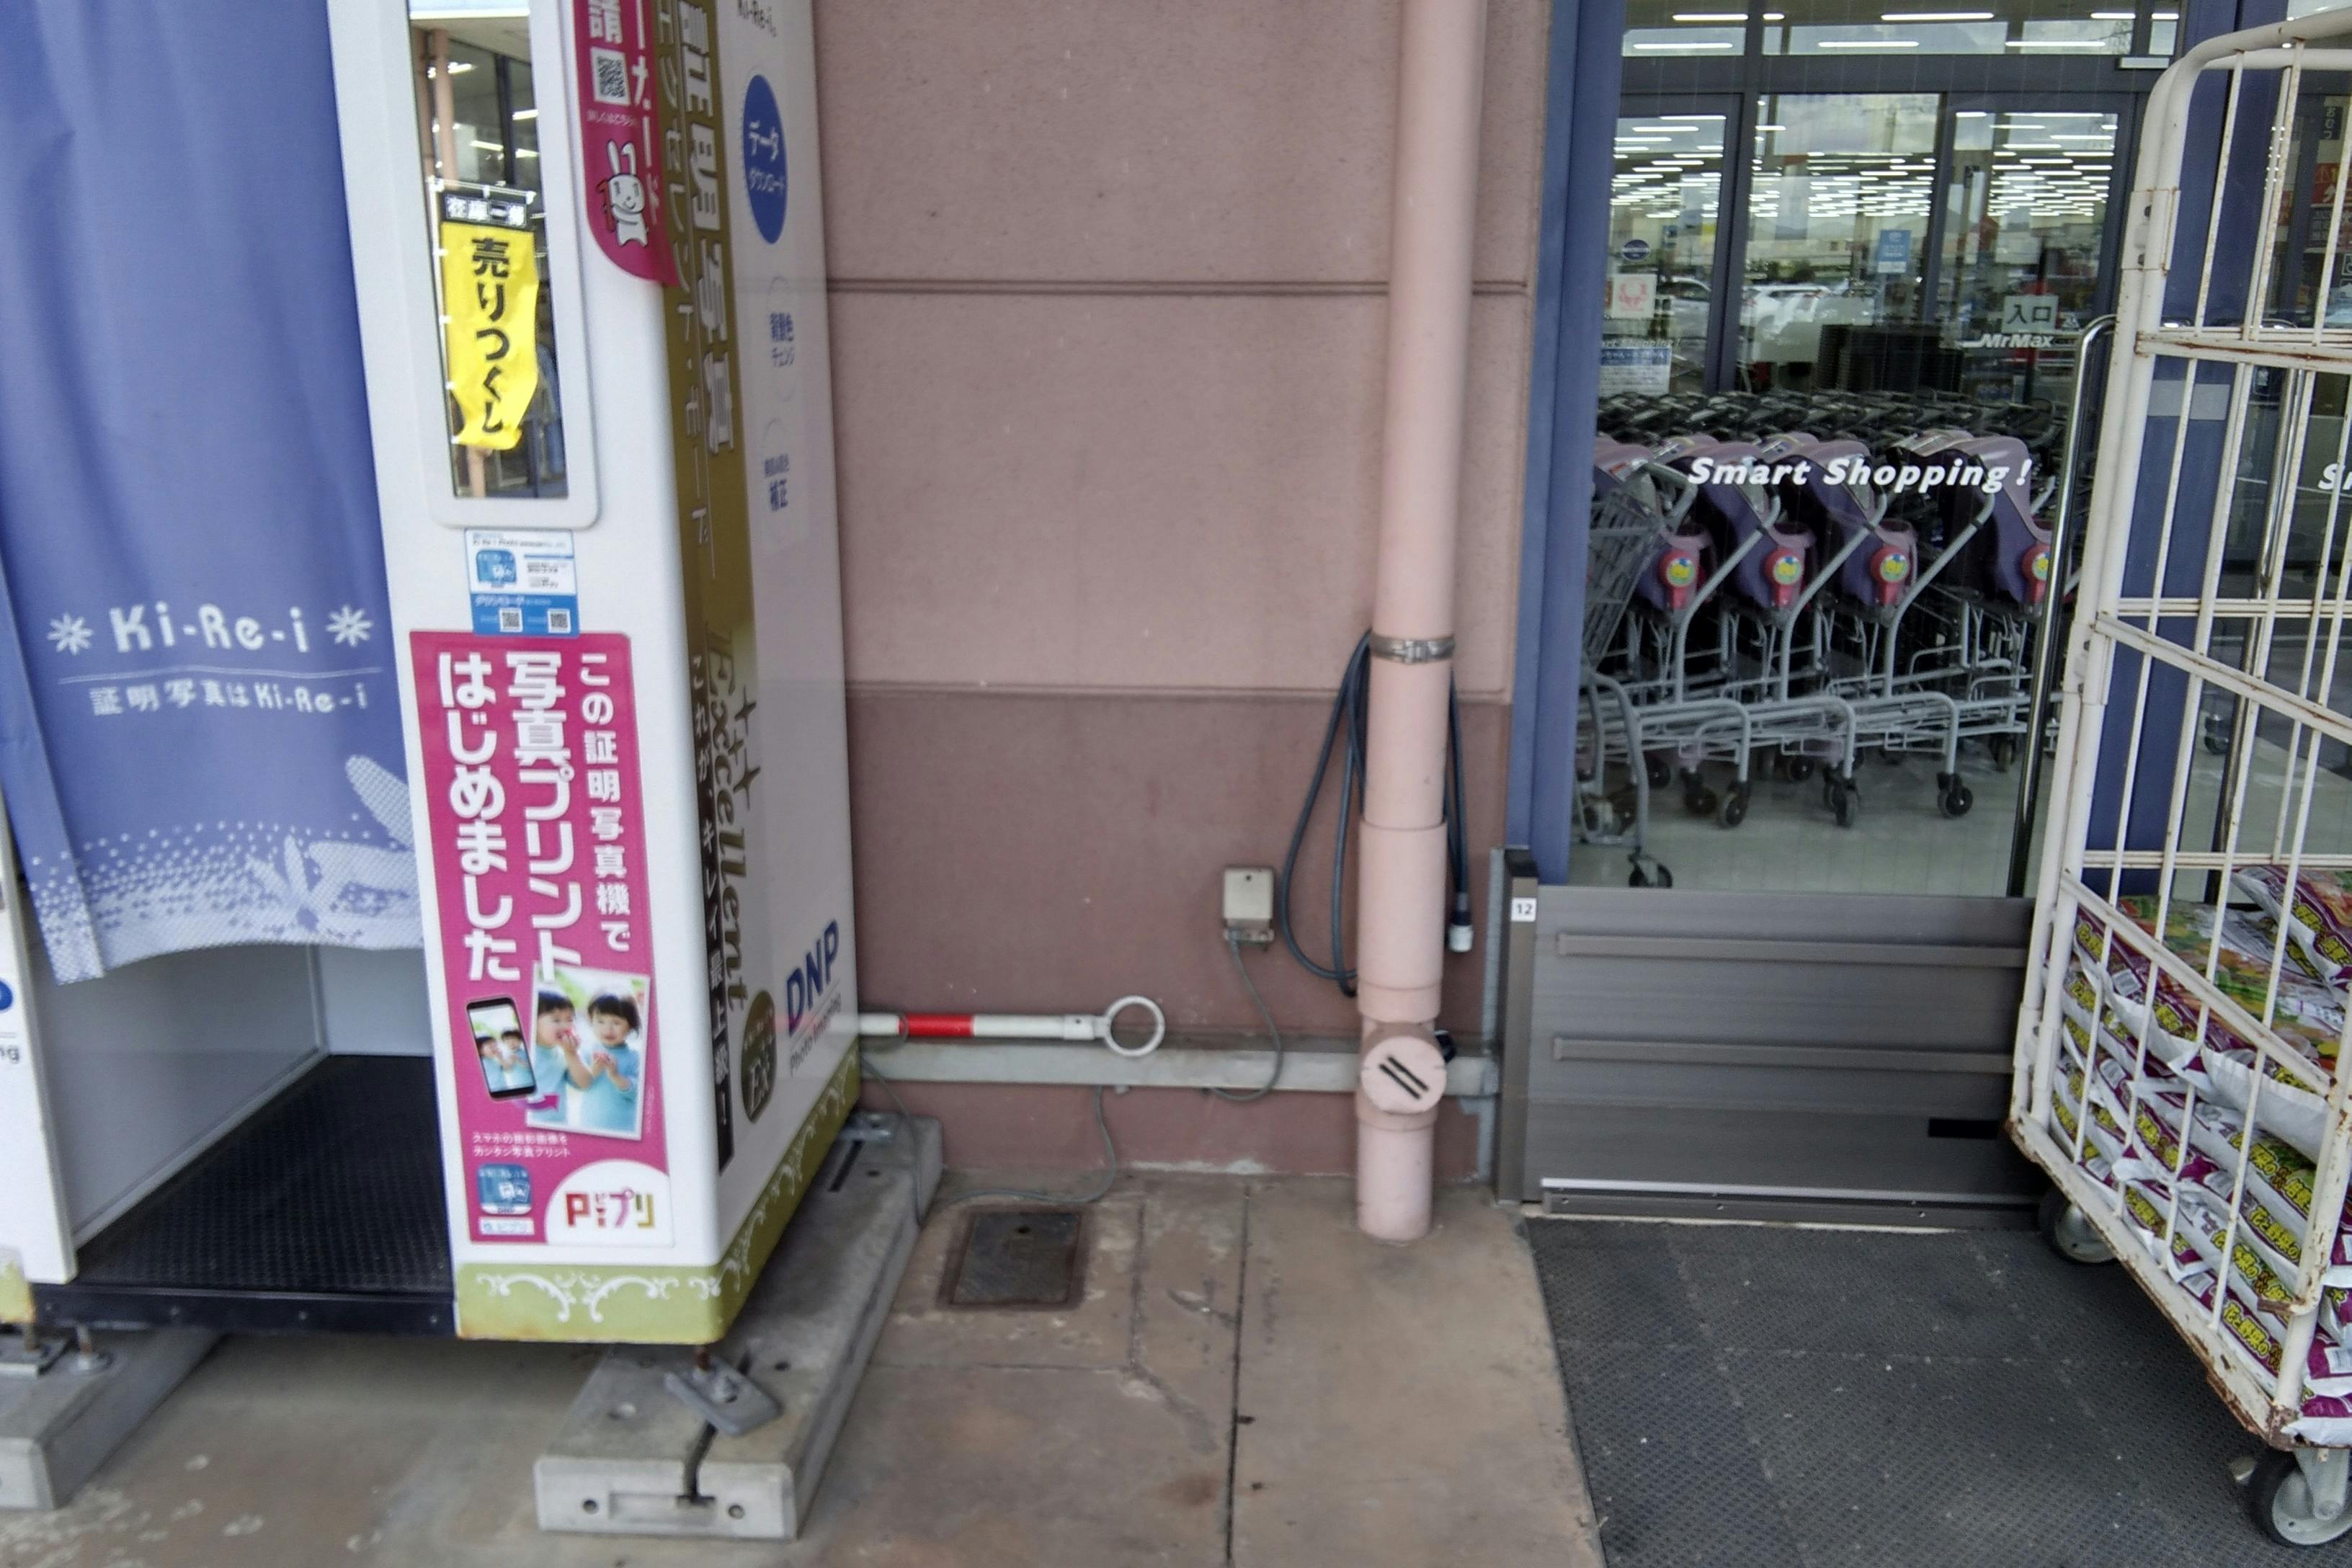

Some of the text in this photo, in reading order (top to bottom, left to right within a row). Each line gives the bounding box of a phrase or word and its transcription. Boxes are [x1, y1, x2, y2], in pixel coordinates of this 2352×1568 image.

[747, 120, 780, 162] データ
[471, 238, 509, 433] 売りつくし
[2007, 304, 2052, 324] 入口
[1981, 334, 2054, 348] MrMax
[1687, 457, 1812, 486] Smart
[109, 601, 310, 654] Ki-Re-i
[88, 678, 368, 716] 証明写真はKi-Re-i
[437, 651, 520, 981] はじめました
[506, 651, 582, 983] 写真プリント
[579, 653, 631, 952] この証明写真機で
[705, 624, 747, 1011] Excellent
[1517, 904, 1533, 915] 12
[786, 918, 839, 1038] DNP
